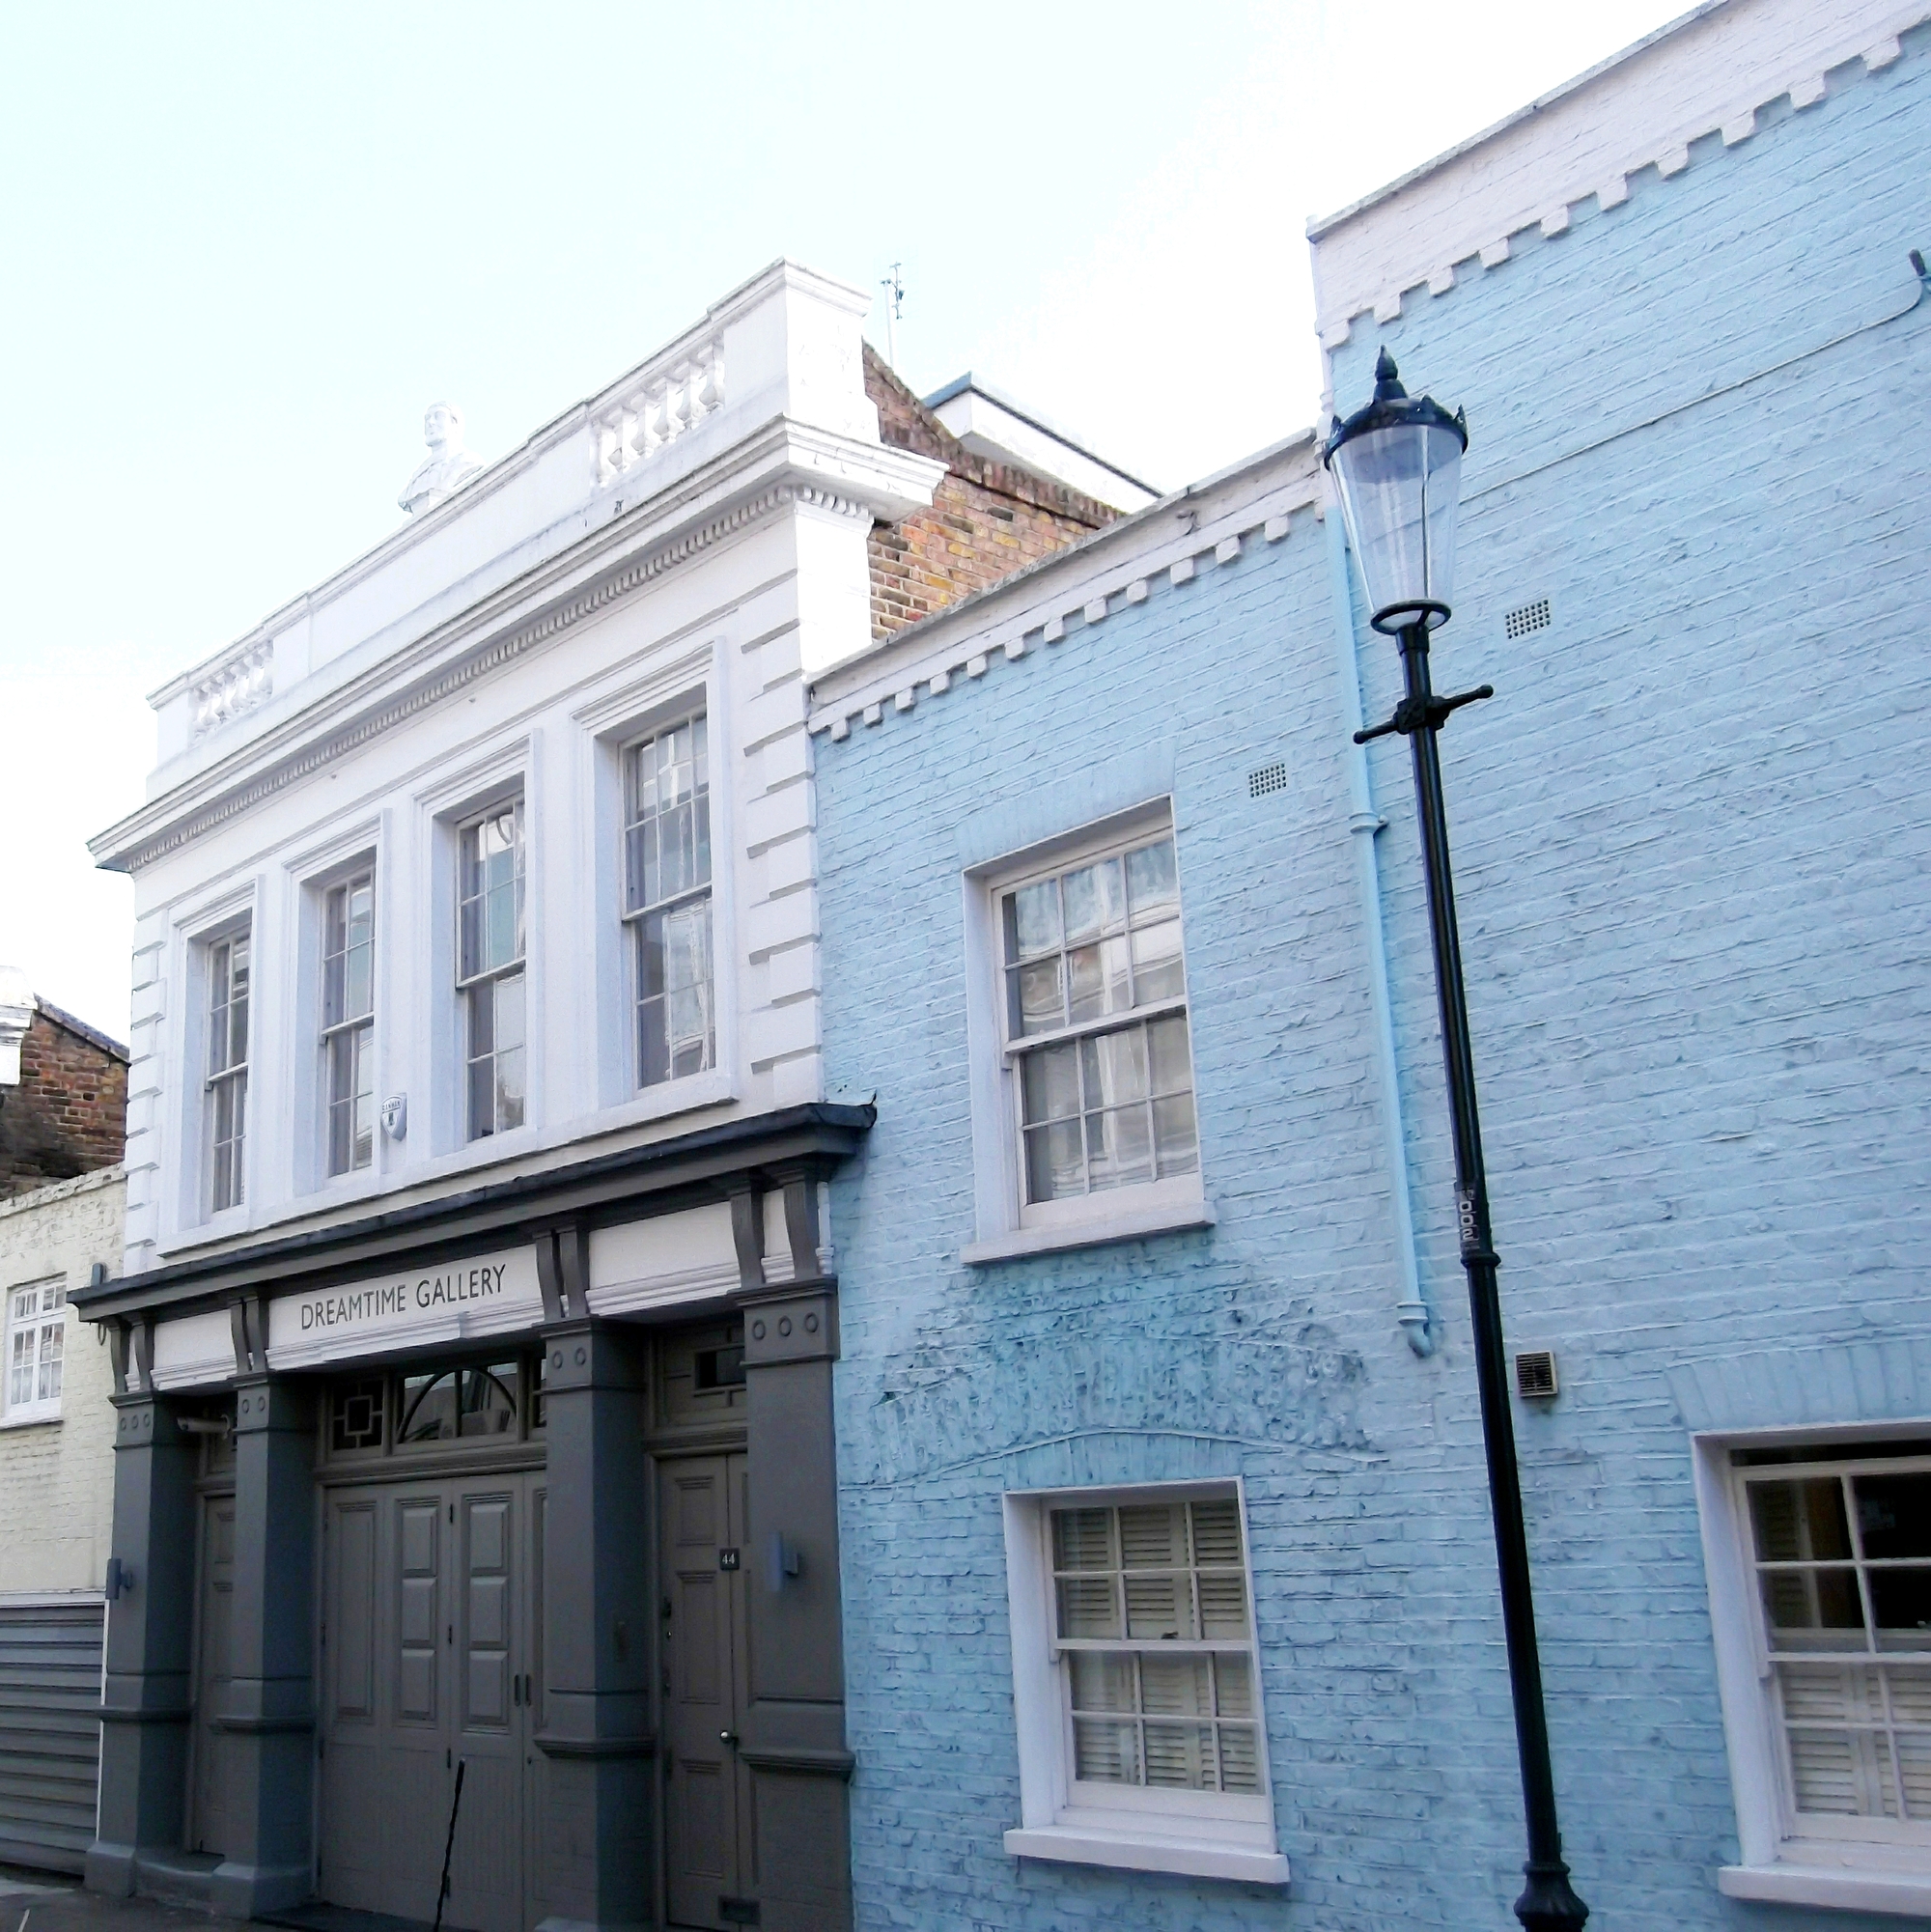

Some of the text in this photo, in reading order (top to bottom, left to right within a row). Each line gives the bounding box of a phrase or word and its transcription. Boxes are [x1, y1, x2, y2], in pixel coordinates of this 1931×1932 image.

[301, 1264, 506, 1330] DREAMTIME GALLERY
[721, 1553, 735, 1564] 44
